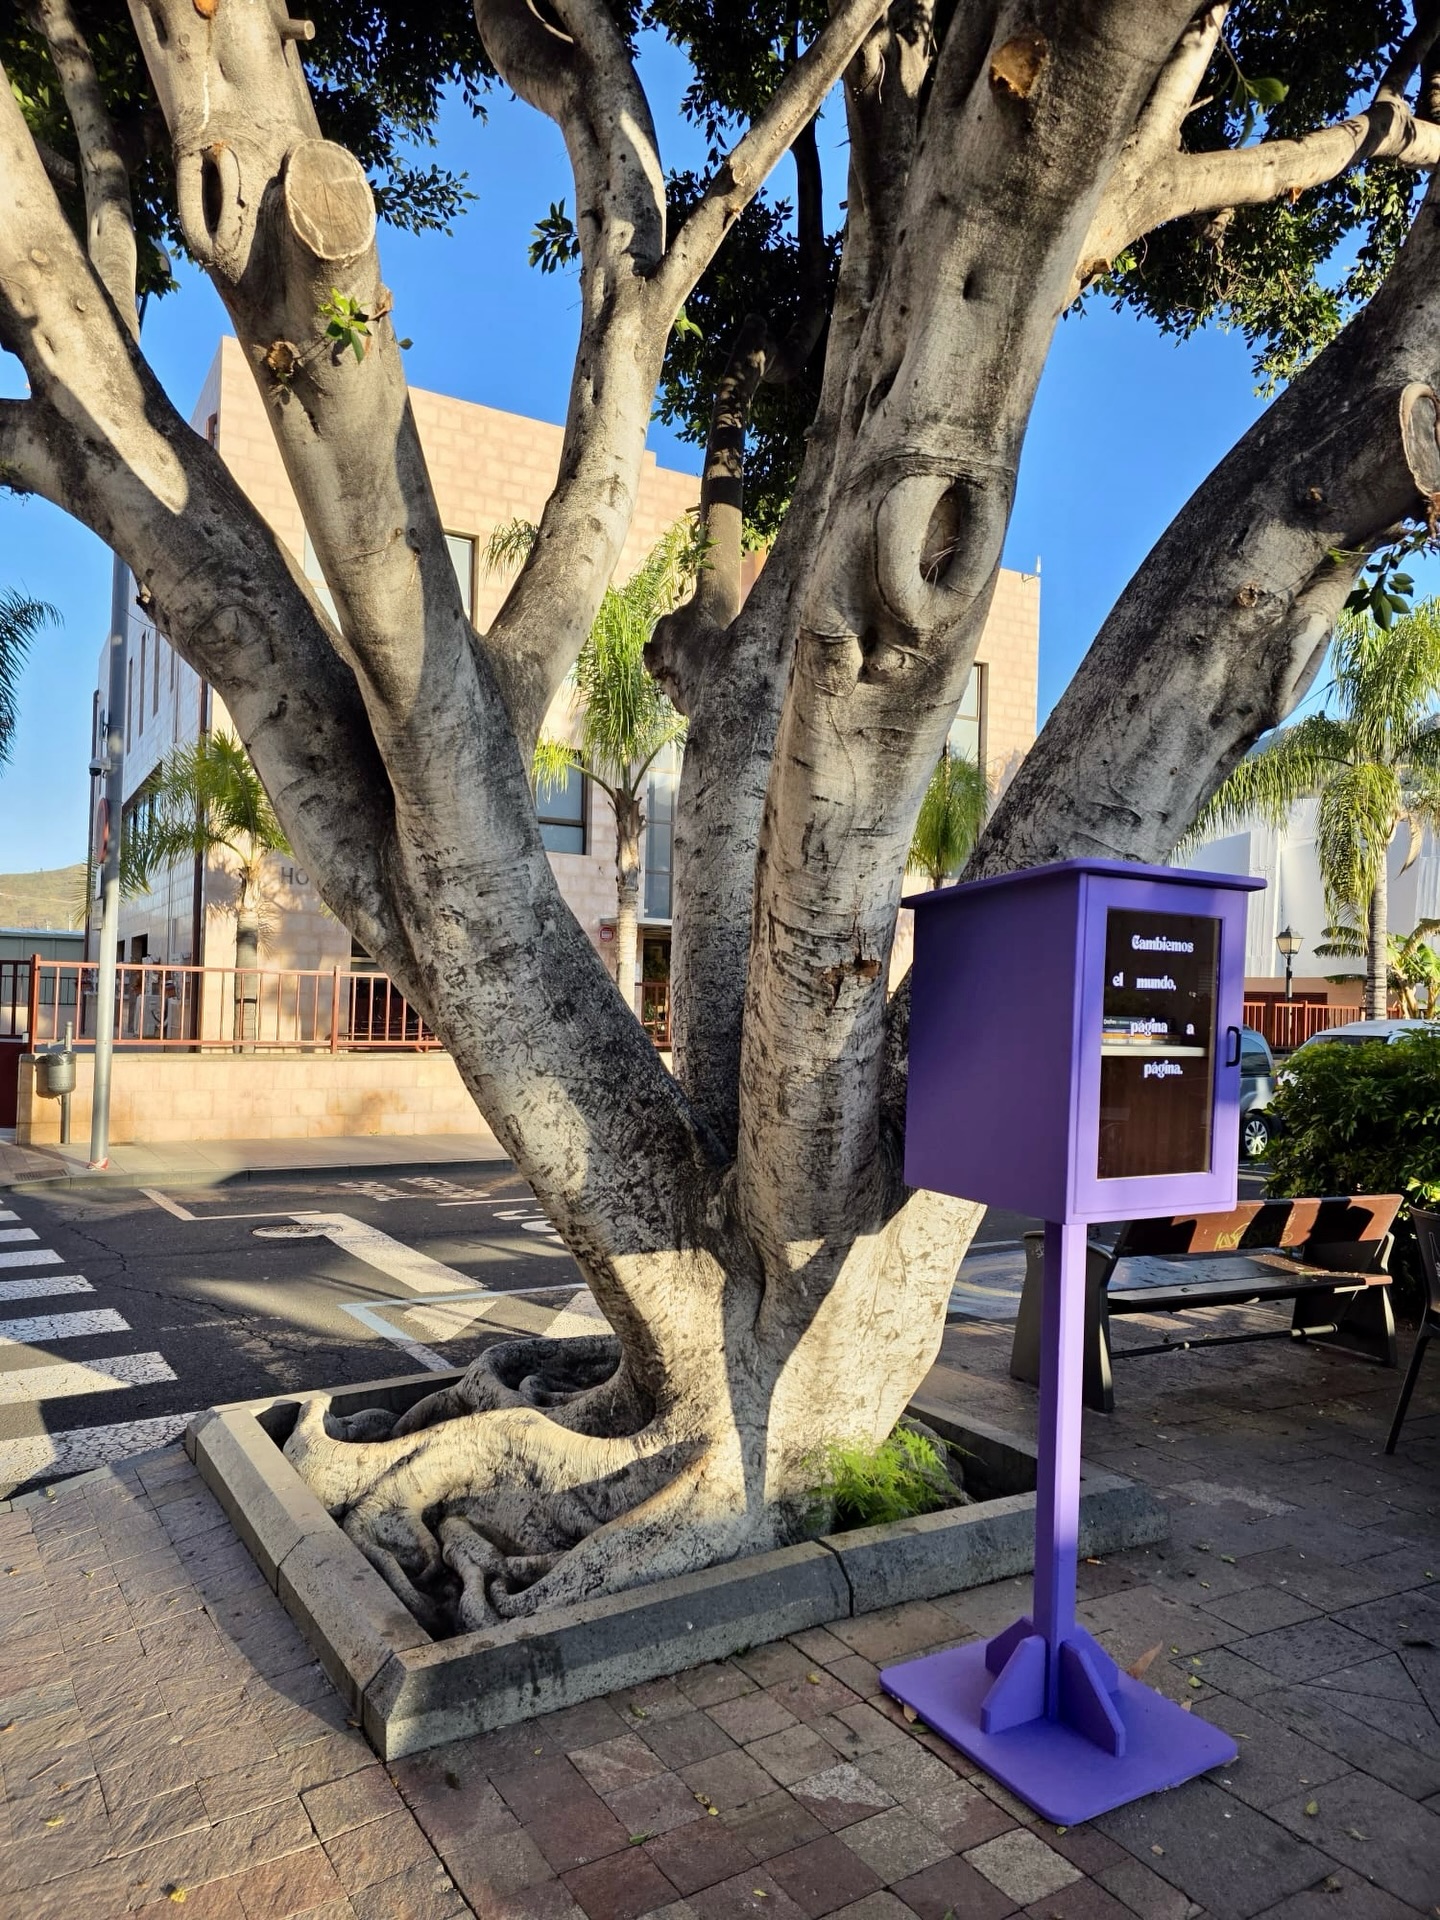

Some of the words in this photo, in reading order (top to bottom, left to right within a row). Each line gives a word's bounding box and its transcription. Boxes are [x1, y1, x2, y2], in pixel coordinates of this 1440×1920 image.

[1132, 935, 1194, 953] Cambiemos
[1112, 972, 1124, 987] el
[1136, 975, 1177, 991] mundo,
[1130, 1018, 1168, 1037] página
[1186, 1023, 1195, 1035] a
[1144, 1060, 1183, 1078] página.
